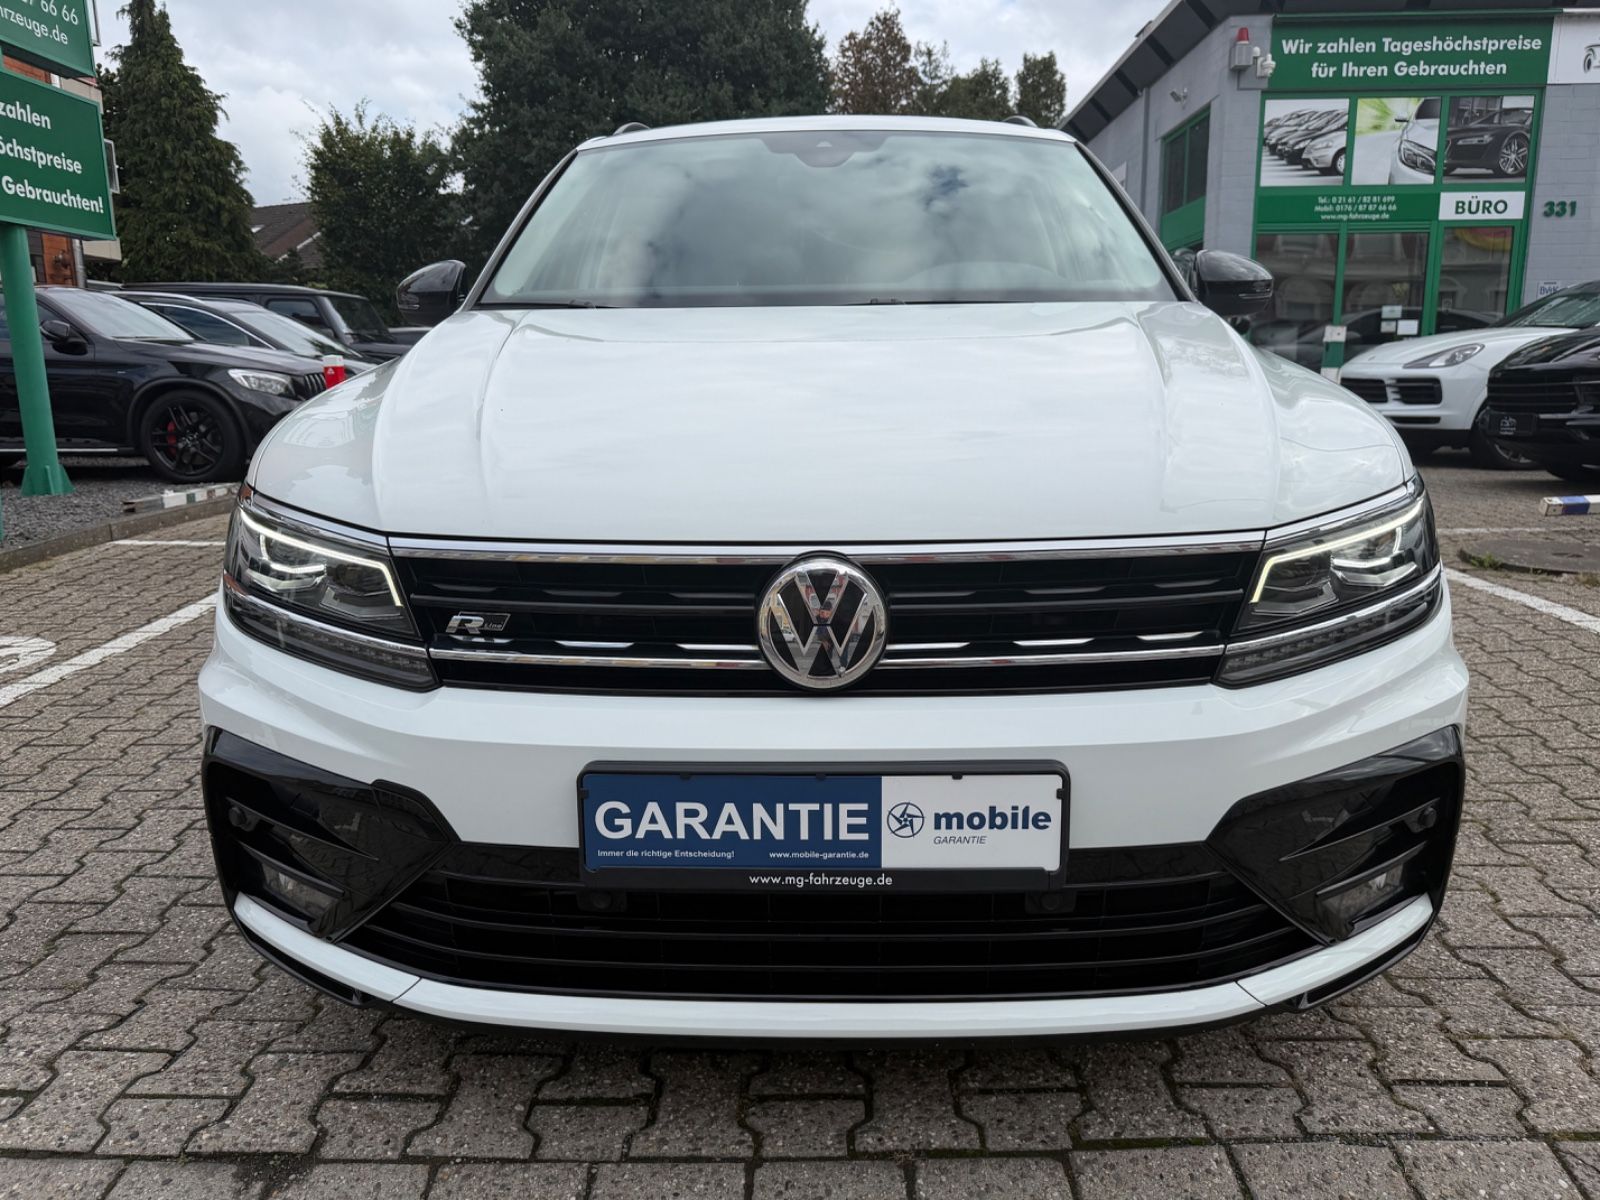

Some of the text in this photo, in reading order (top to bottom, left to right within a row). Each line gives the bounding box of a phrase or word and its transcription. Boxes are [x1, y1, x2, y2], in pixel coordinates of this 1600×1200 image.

[62, 5, 79, 25] 66
[1282, 34, 1542, 55] Wir zahlen Tageshöchstpreise
[1311, 59, 1507, 78] für Ihren Gebrauchten
[0, 101, 51, 130] zahlen
[2, 175, 104, 214] Gebrauchten!
[1455, 195, 1508, 215] BÜRO
[1543, 201, 1577, 218] 331
[445, 615, 484, 634] R
[594, 800, 870, 840] GARANTIE
[933, 805, 1052, 831] mobile
[933, 835, 987, 845] GARANTIE
[597, 849, 735, 859] Immer die richtige Entscheidung!
[769, 850, 869, 860] www.mobile-garantie.de
[749, 872, 893, 888] www.mg-fahrzeuge.de
